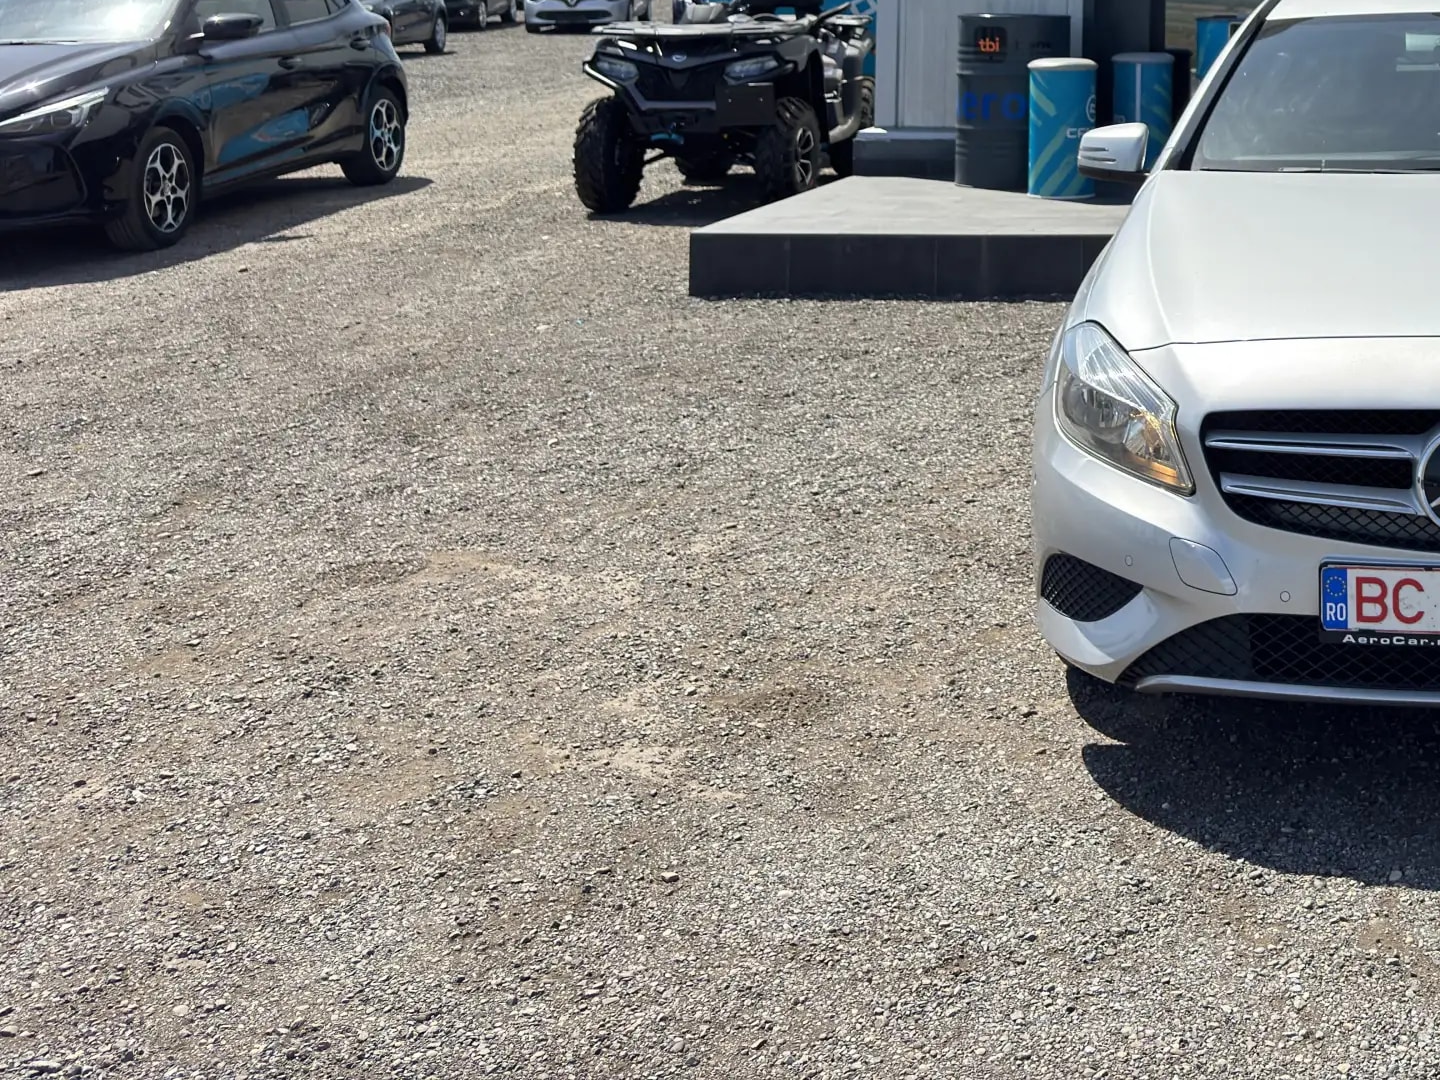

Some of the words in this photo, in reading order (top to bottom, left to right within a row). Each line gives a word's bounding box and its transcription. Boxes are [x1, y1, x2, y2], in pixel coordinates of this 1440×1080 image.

[978, 37, 1000, 53] tbi
[1355, 576, 1425, 624] BC
[1326, 602, 1347, 622] RO
